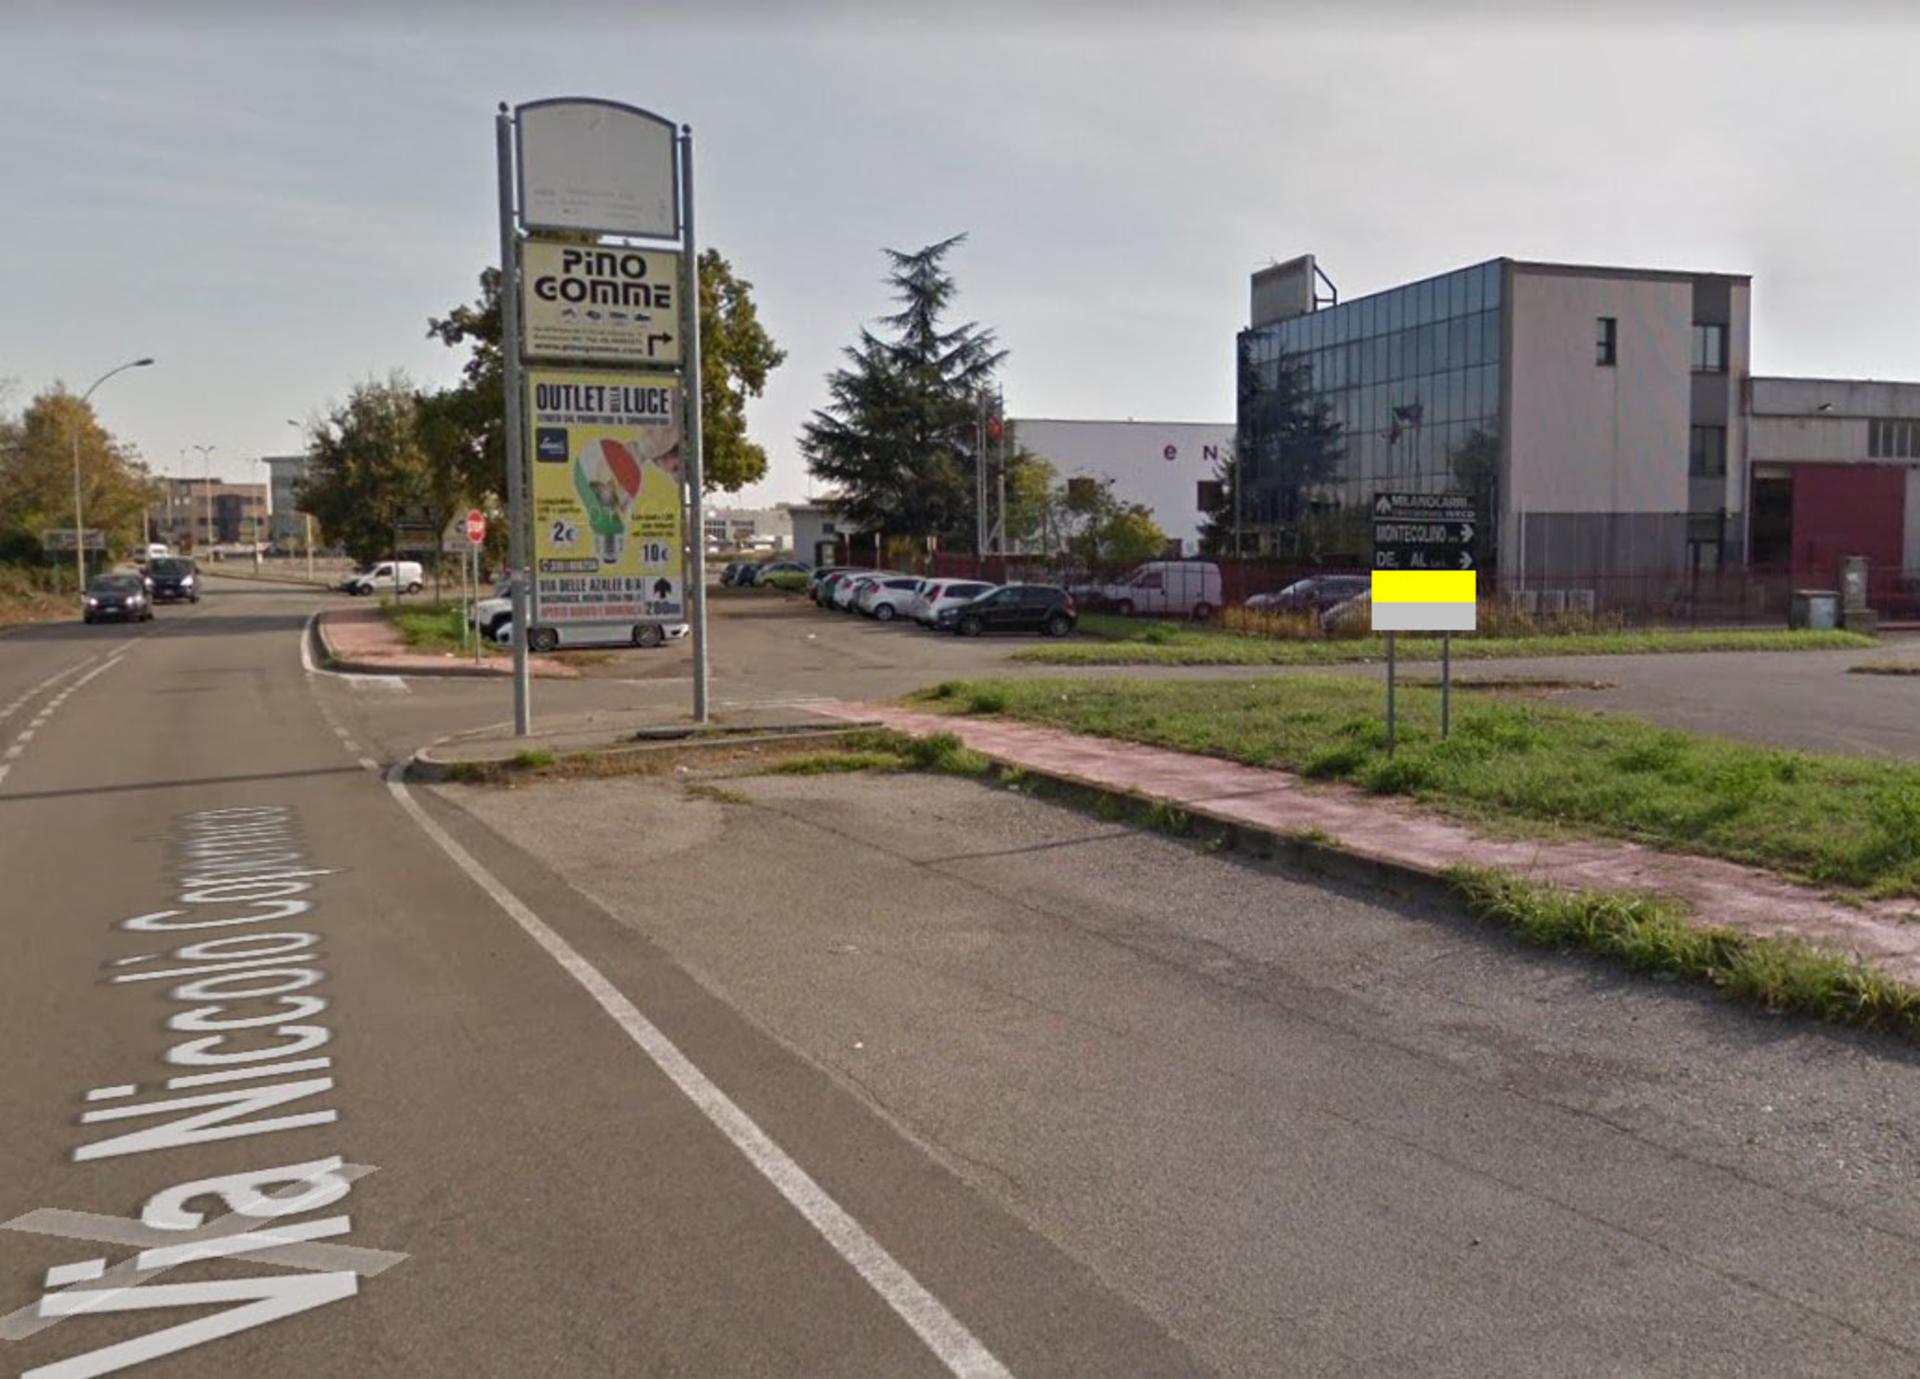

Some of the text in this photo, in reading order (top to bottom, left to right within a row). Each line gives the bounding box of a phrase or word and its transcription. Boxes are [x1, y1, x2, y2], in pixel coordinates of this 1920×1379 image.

[534, 276, 671, 309] GOMME
[536, 383, 605, 412] OUTLET
[623, 387, 669, 414] LUCE
[466, 520, 485, 533] STOP
